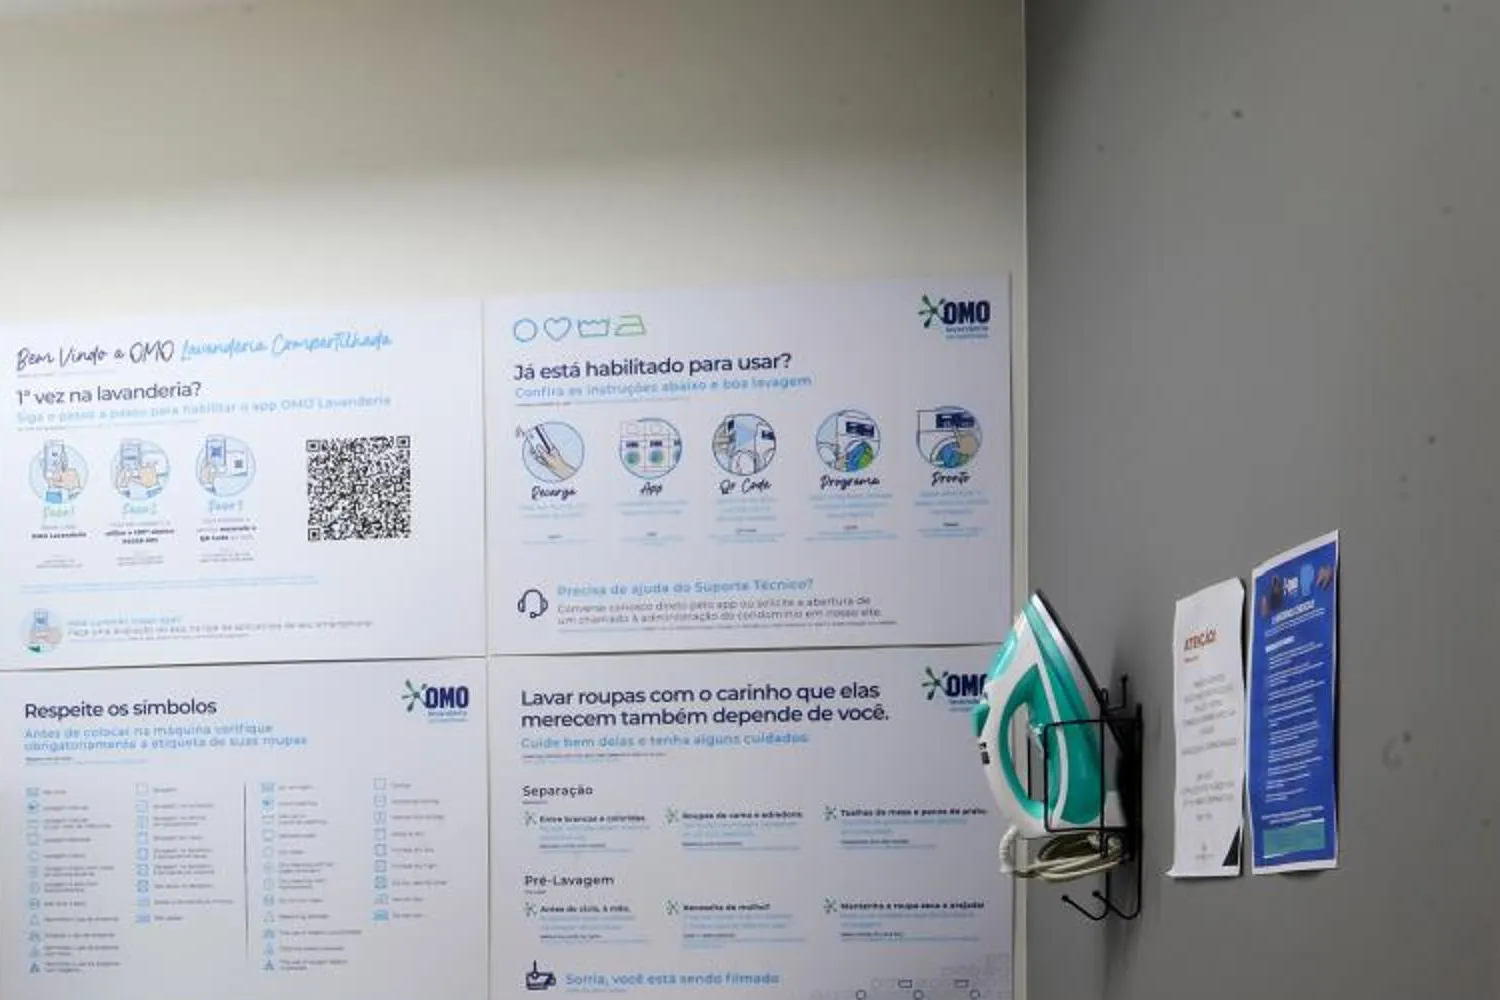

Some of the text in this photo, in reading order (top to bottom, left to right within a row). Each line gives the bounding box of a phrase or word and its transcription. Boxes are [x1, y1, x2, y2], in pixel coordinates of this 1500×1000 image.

[942, 301, 990, 324] OMO
[16, 346, 55, 372] Bem
[59, 345, 108, 368] Vindo
[129, 339, 175, 363] OMO
[180, 337, 268, 361] Lavanderia
[271, 330, 393, 356] Compartilhada
[513, 352, 792, 381] Já está habilitado para usar?
[34, 390, 65, 405] vez
[69, 389, 93, 403] na
[97, 381, 201, 401] lavanderia?
[515, 375, 812, 399] Confira as instruções abaixo e boa lavagem
[741, 476, 772, 494] Code
[820, 474, 880, 491] Programa
[931, 471, 971, 487] Pronto
[640, 482, 663, 496] App
[610, 584, 627, 595] de
[631, 582, 669, 597] ajuda
[673, 581, 690, 593] do
[694, 580, 749, 595] Suporte
[754, 577, 814, 592] Técnico?
[426, 686, 469, 709] OMO
[521, 682, 881, 708] Lavar roupas com o carinho que elas
[25, 698, 218, 721] Respeite os símbolos
[521, 703, 890, 728] merecem também depende de você.
[24, 728, 60, 739] Antes
[65, 727, 80, 739] de
[134, 727, 150, 737] na
[214, 722, 274, 736] verifique
[151, 735, 308, 750] etiqueta de suas roupas
[521, 731, 809, 750] Cuide bem delas e tenha alguns cuidados
[522, 783, 594, 799] Separação
[524, 874, 615, 888] Pré-Lavagem
[565, 972, 780, 987] Sorria, você está sendo filmado
